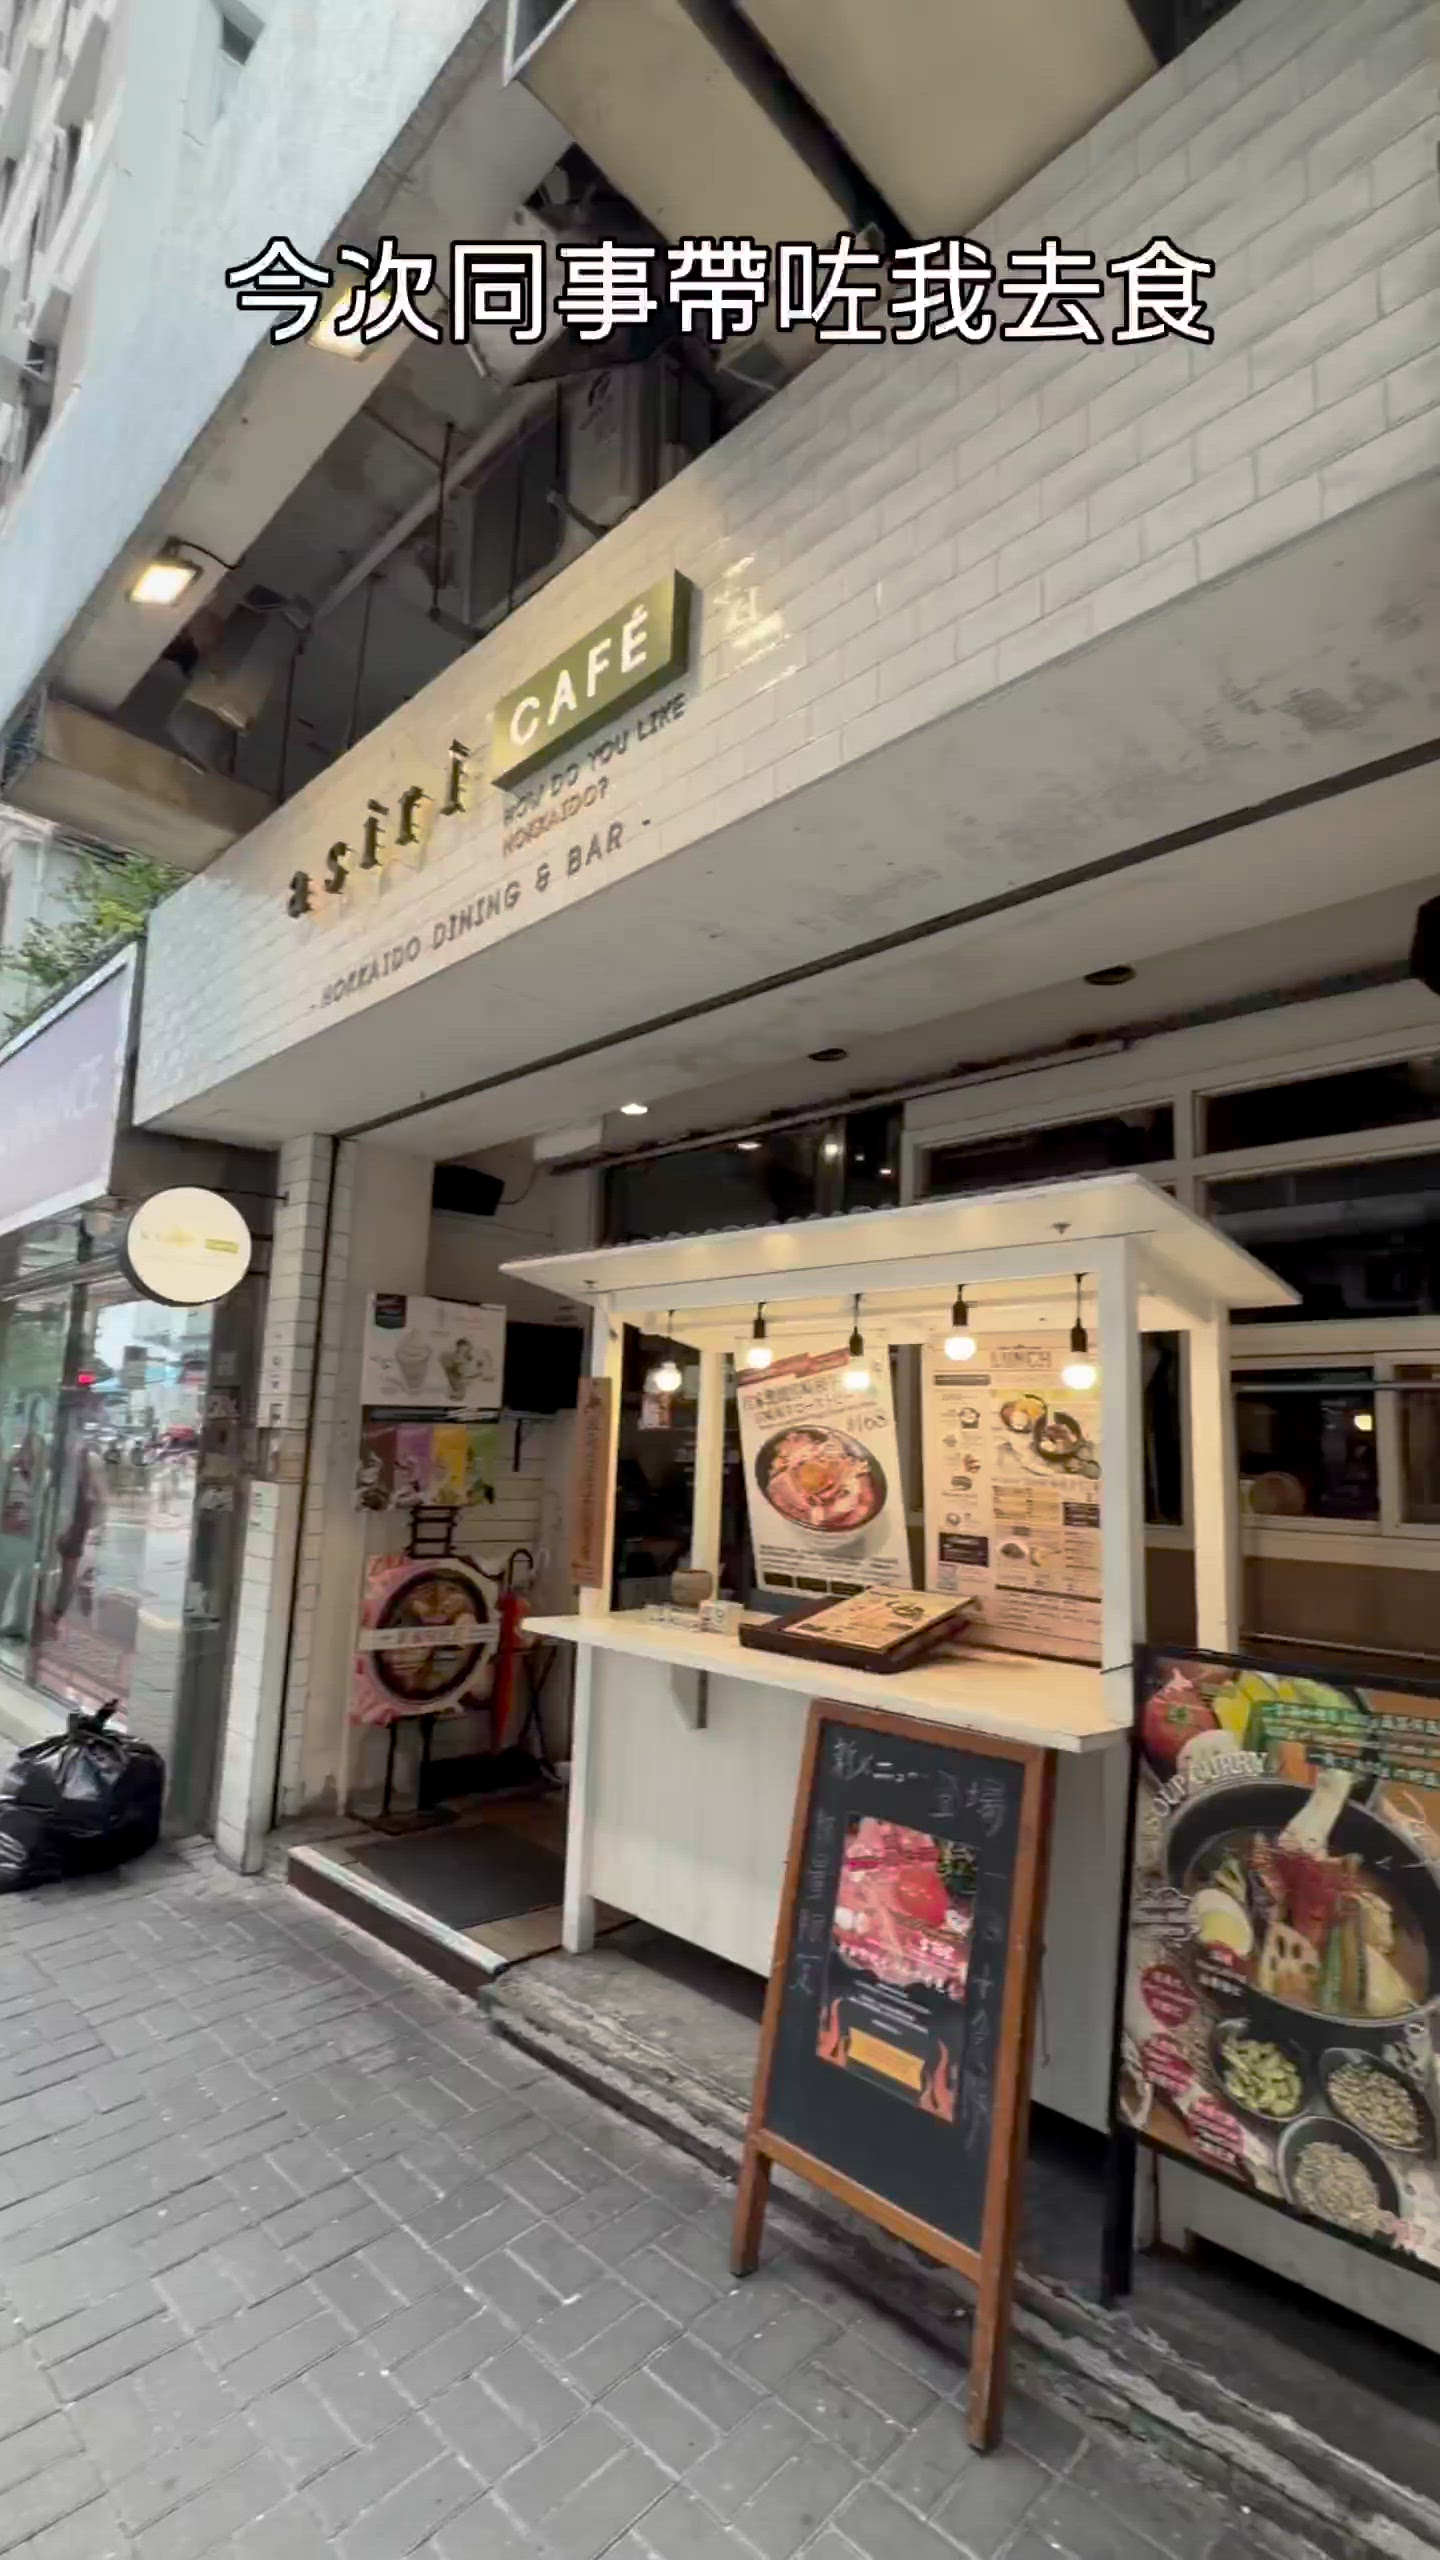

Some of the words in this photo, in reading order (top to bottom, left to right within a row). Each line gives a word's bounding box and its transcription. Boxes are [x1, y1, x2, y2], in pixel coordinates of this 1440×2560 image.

[509, 604, 649, 747] CAFÉ
[503, 785, 545, 826] HOW
[550, 762, 580, 797] DO
[587, 731, 630, 772] YOU
[637, 692, 686, 742] LIKE
[321, 936, 422, 1008] HOKKAIDO
[432, 881, 522, 951] DINING
[534, 862, 552, 893] &
[567, 821, 624, 879] BAR
